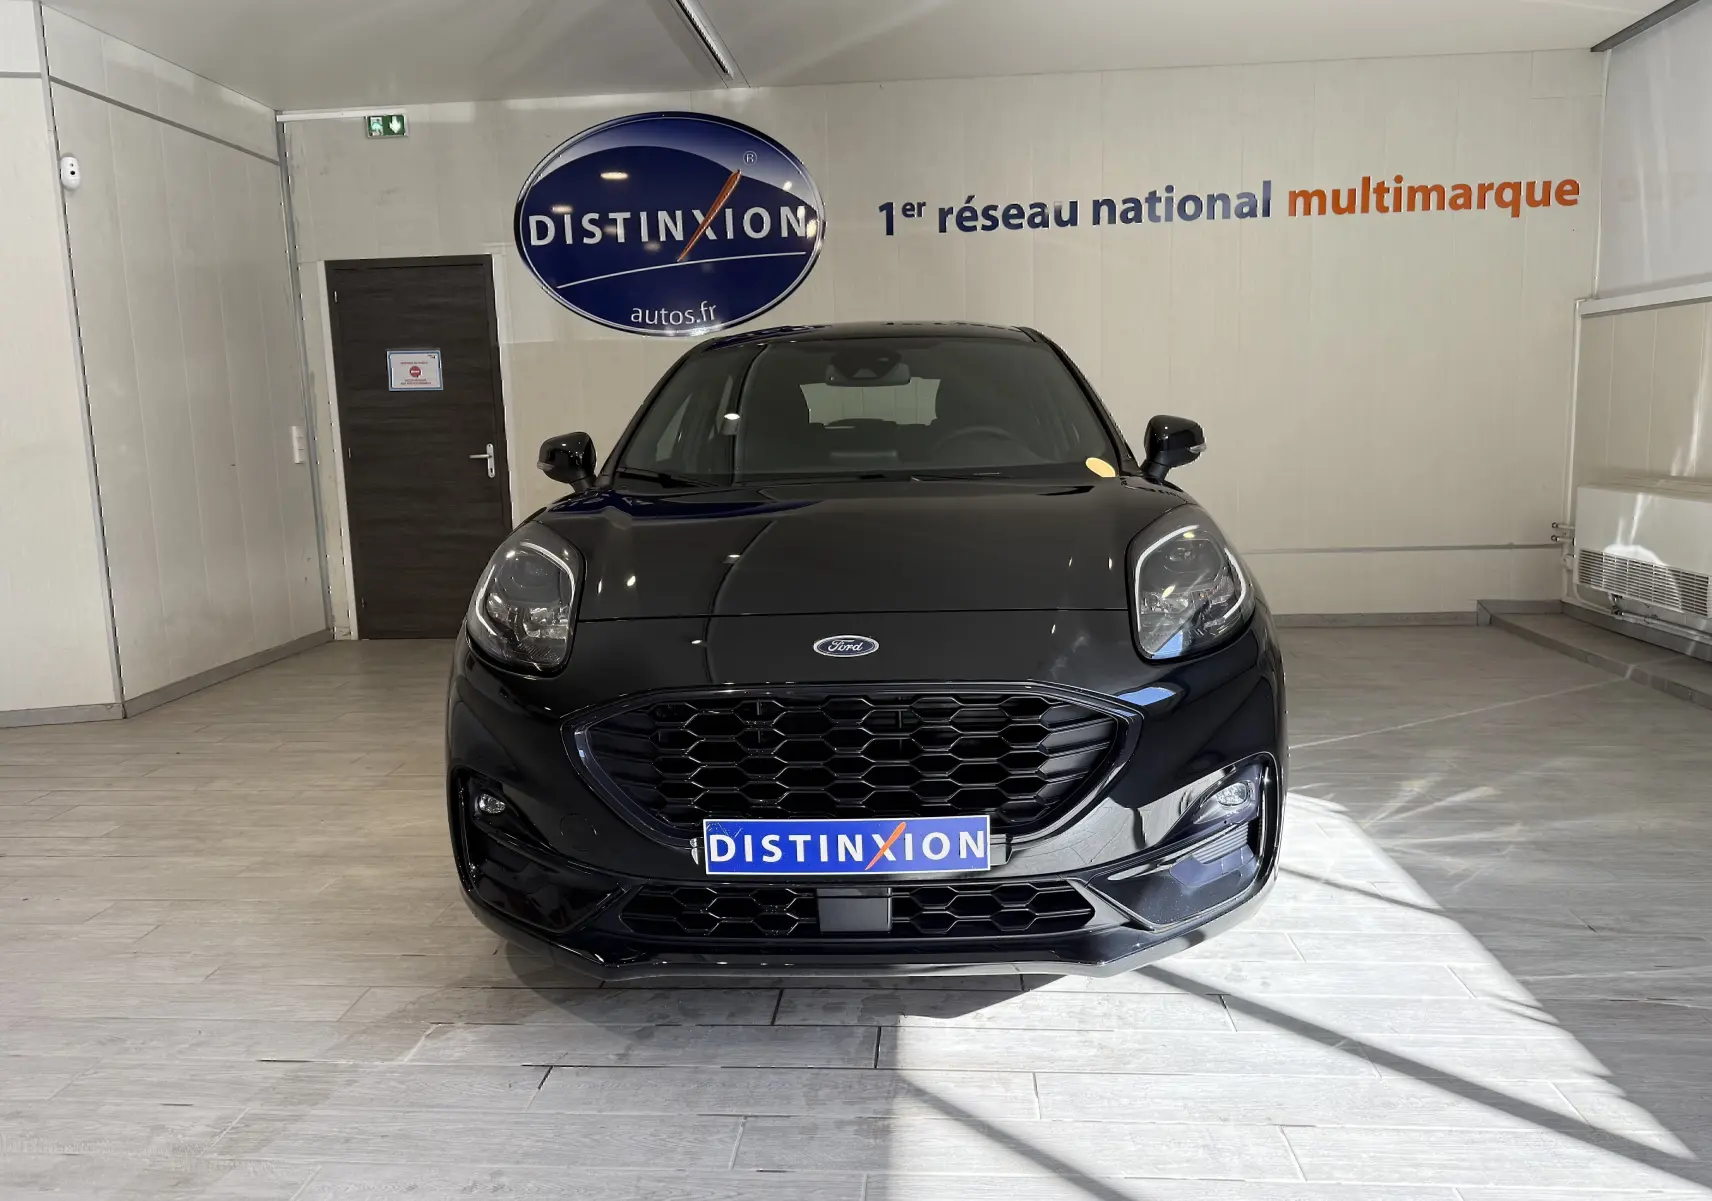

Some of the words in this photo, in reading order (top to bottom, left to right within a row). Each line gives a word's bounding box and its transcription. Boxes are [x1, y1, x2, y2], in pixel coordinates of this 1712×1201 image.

[938, 195, 1079, 234] réseau
[1092, 180, 1272, 226] national
[1288, 174, 1580, 218] multimarque
[631, 300, 718, 326] autos.fr
[827, 639, 864, 652] Ford
[708, 821, 986, 871] DISTINXION
